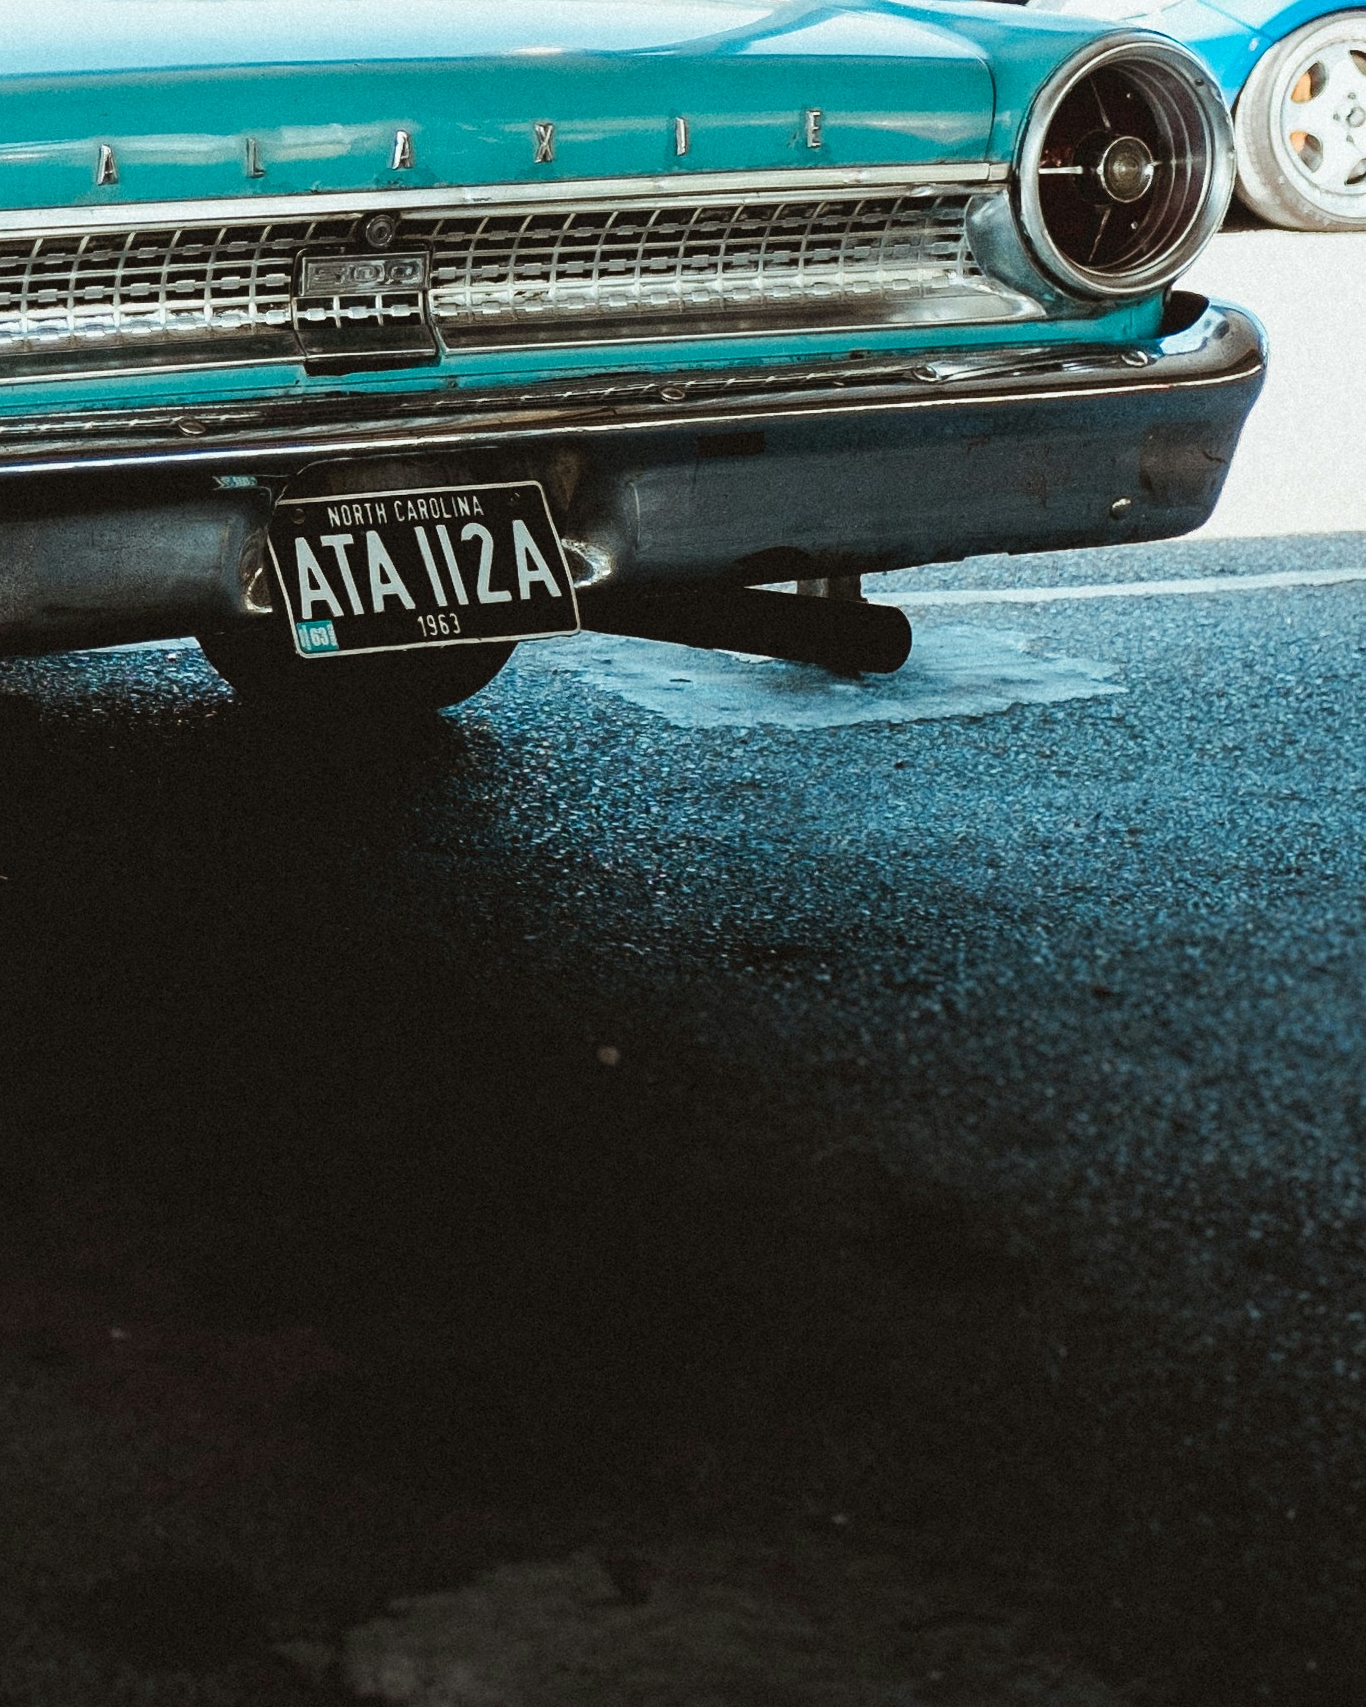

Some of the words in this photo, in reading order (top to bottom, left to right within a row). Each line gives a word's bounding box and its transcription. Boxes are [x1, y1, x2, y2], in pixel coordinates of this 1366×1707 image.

[328, 502, 387, 528] NORTH
[394, 496, 484, 522] CAROLINA
[294, 530, 416, 619] ATA
[415, 519, 562, 605] 112A
[417, 613, 461, 637] 1963
